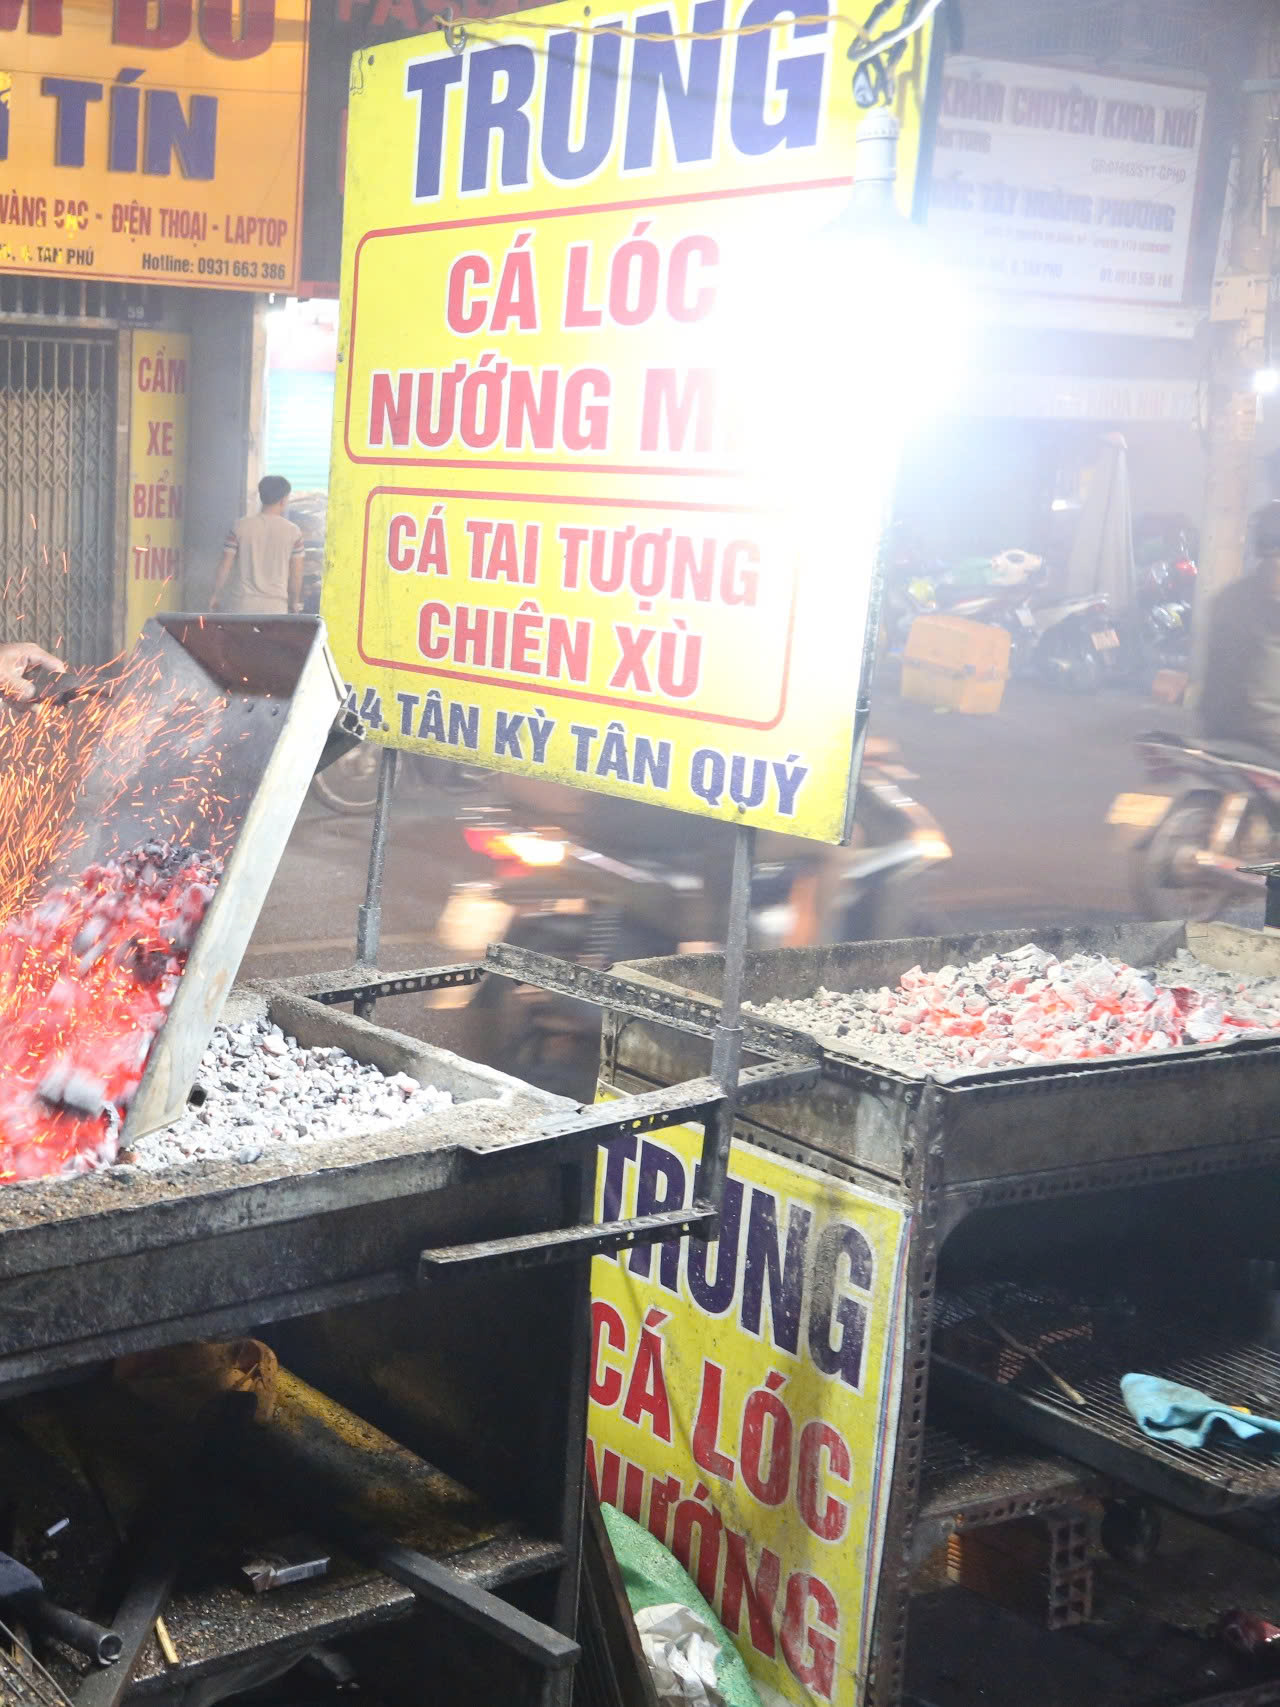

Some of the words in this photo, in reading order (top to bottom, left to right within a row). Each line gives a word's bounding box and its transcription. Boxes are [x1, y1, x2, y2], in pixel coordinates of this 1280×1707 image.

[41, 67, 219, 181] TÍN
[406, 0, 829, 198] TRUNG
[111, 199, 152, 243] ĐIỆN
[159, 207, 208, 248] THOẠI
[224, 214, 288, 248] LAPTOP
[141, 253, 195, 273] Hotline:
[197, 257, 230, 276] 0931
[233, 261, 258, 278] 663
[446, 232, 541, 335] CÁ
[564, 220, 720, 330] LÓC
[137, 345, 187, 394] CẦM
[368, 352, 613, 451] NƯỚNG
[146, 420, 174, 456] XE
[386, 505, 449, 577] CÁ
[465, 520, 540, 586] TAI
[558, 524, 761, 613] TƯỢNG
[418, 600, 592, 685] CHIÊN
[610, 617, 703, 699] XÙ
[397, 688, 480, 750] TÂN
[494, 706, 555, 764] KỲ
[571, 721, 671, 791] TÂN
[690, 752, 810, 815] QUÝ
[598, 1132, 877, 1390] TRUNG
[589, 1300, 673, 1444] CÁ
[692, 1360, 852, 1542] LÓC
